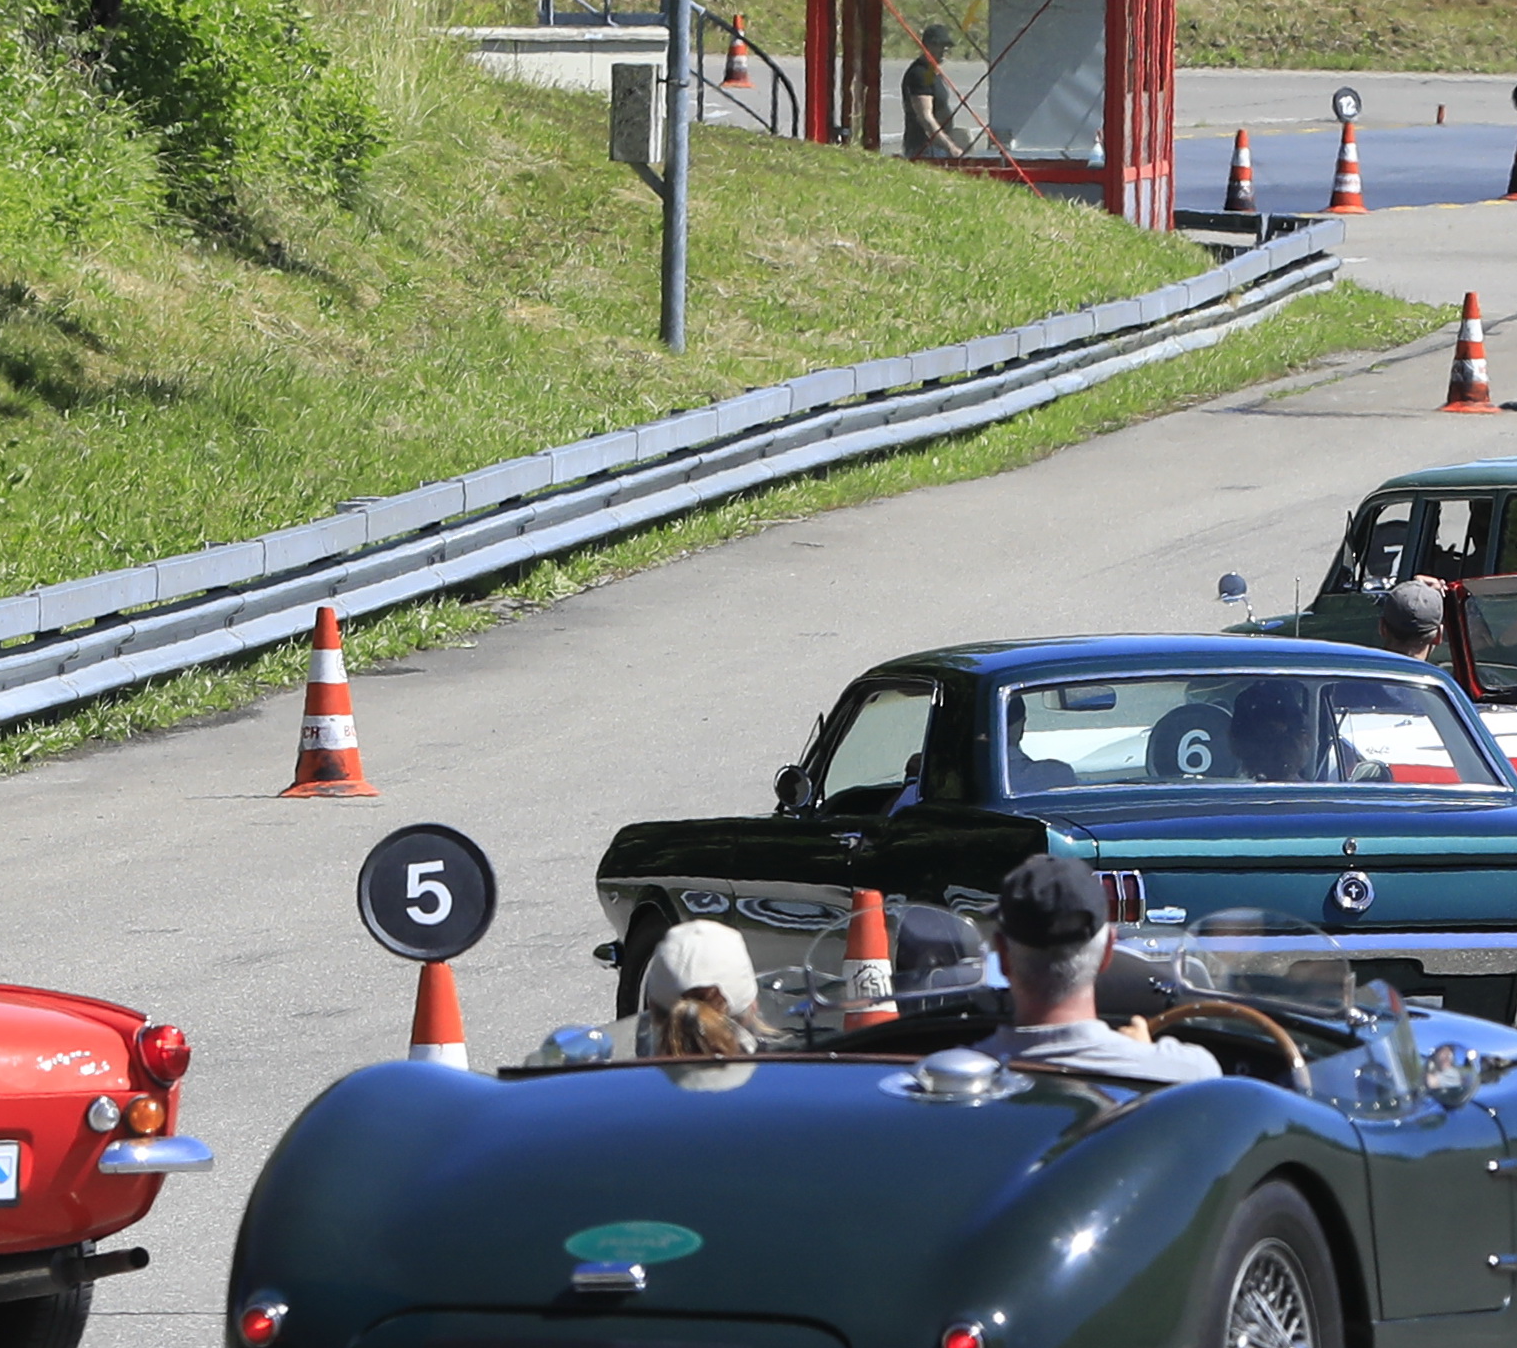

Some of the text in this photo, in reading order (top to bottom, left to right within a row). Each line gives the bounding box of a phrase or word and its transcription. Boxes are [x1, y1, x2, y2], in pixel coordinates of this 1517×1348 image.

[1339, 95, 1358, 116] 12
[1383, 544, 1404, 578] 7
[1176, 728, 1213, 774] 6
[405, 859, 453, 926] 5
